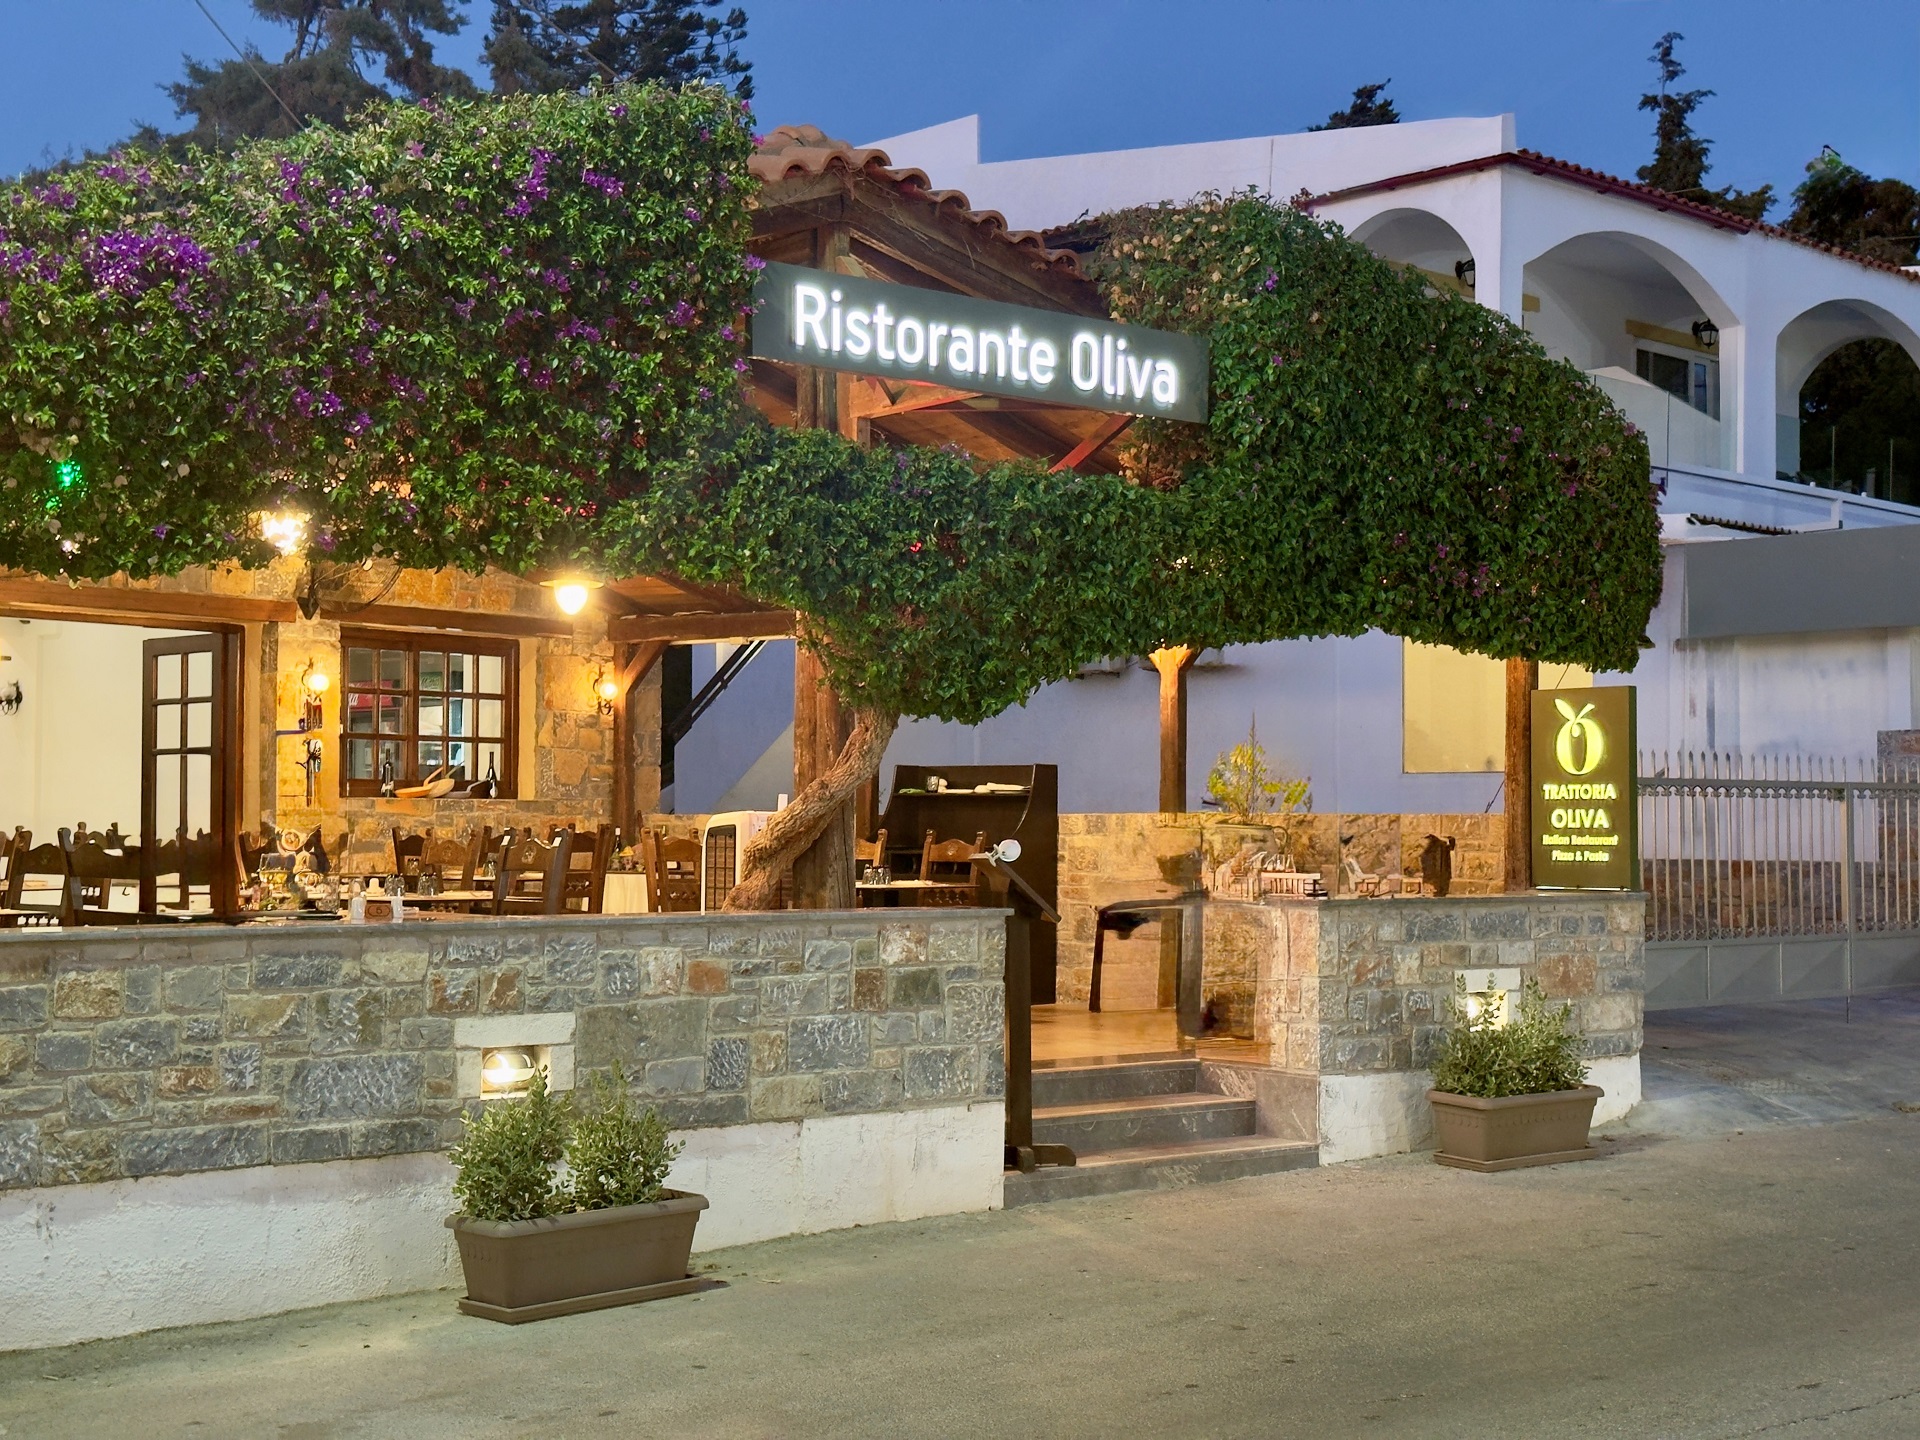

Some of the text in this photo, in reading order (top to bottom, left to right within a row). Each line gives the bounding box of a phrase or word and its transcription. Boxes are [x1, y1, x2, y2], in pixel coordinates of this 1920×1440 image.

[795, 283, 1178, 404] Ristorante Oliva
[1543, 783, 1617, 800] TRATTORIA
[1551, 808, 1610, 829] OLIVA
[1543, 834, 1619, 846] Italian Restaurant
[1552, 850, 1610, 862] Pizza & Pasta
